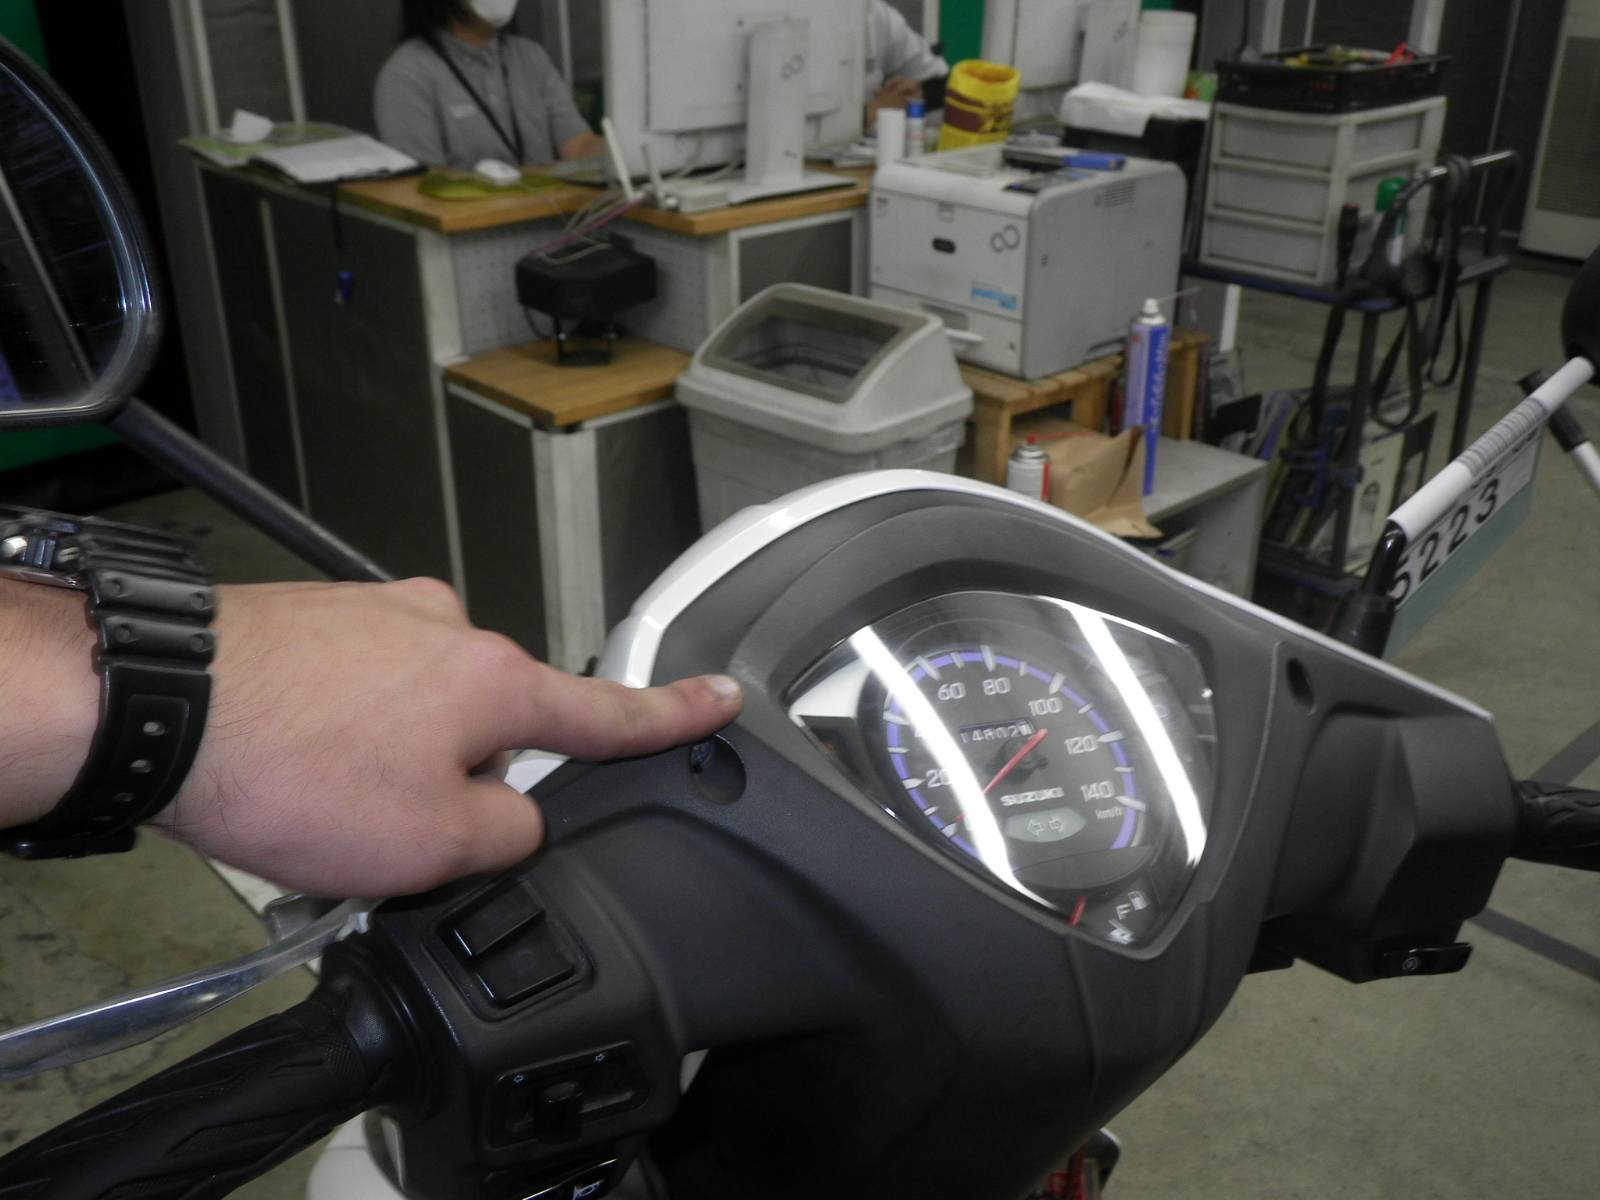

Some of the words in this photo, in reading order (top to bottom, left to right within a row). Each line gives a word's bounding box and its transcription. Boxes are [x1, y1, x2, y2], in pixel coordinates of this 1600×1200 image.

[1387, 478, 1499, 606] 5223
[938, 682, 966, 701] 60
[982, 677, 1011, 695] 80
[1028, 698, 1062, 715] 100
[1065, 735, 1098, 755] 120
[1000, 787, 1064, 806] SUZUKI
[1081, 781, 1114, 802] 140
[1116, 903, 1131, 920] F
